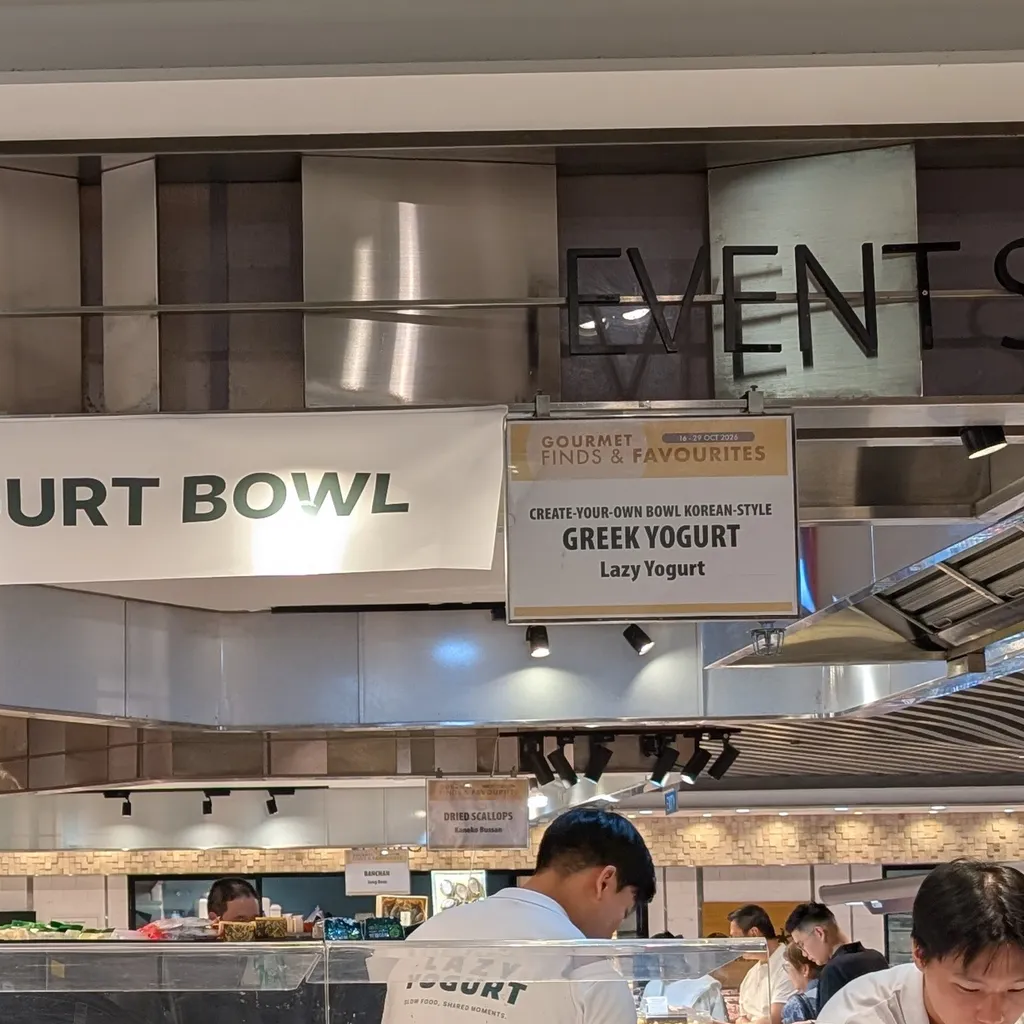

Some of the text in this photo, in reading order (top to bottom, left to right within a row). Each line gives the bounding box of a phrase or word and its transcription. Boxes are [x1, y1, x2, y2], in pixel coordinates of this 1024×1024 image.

[541, 434, 633, 448] GOURMET
[703, 433, 719, 441] OCT
[541, 446, 766, 465] FINDS & FAVOURITES
[182, 472, 409, 523] BOWL
[529, 503, 773, 520] CREATE-YOUR-OWN BOWL KOREAN-STYLE
[562, 524, 741, 551] GREEK YOGURT
[600, 560, 706, 582] Lazy Yogurt
[443, 811, 513, 821] DRIED SCALLOPS
[425, 956, 521, 979] LAZY
[406, 973, 527, 1005] YOGURT
[420, 998, 440, 1007] FOOD,
[443, 1001, 469, 1011] SHARED
[471, 1006, 507, 1019] MOMENTS.
